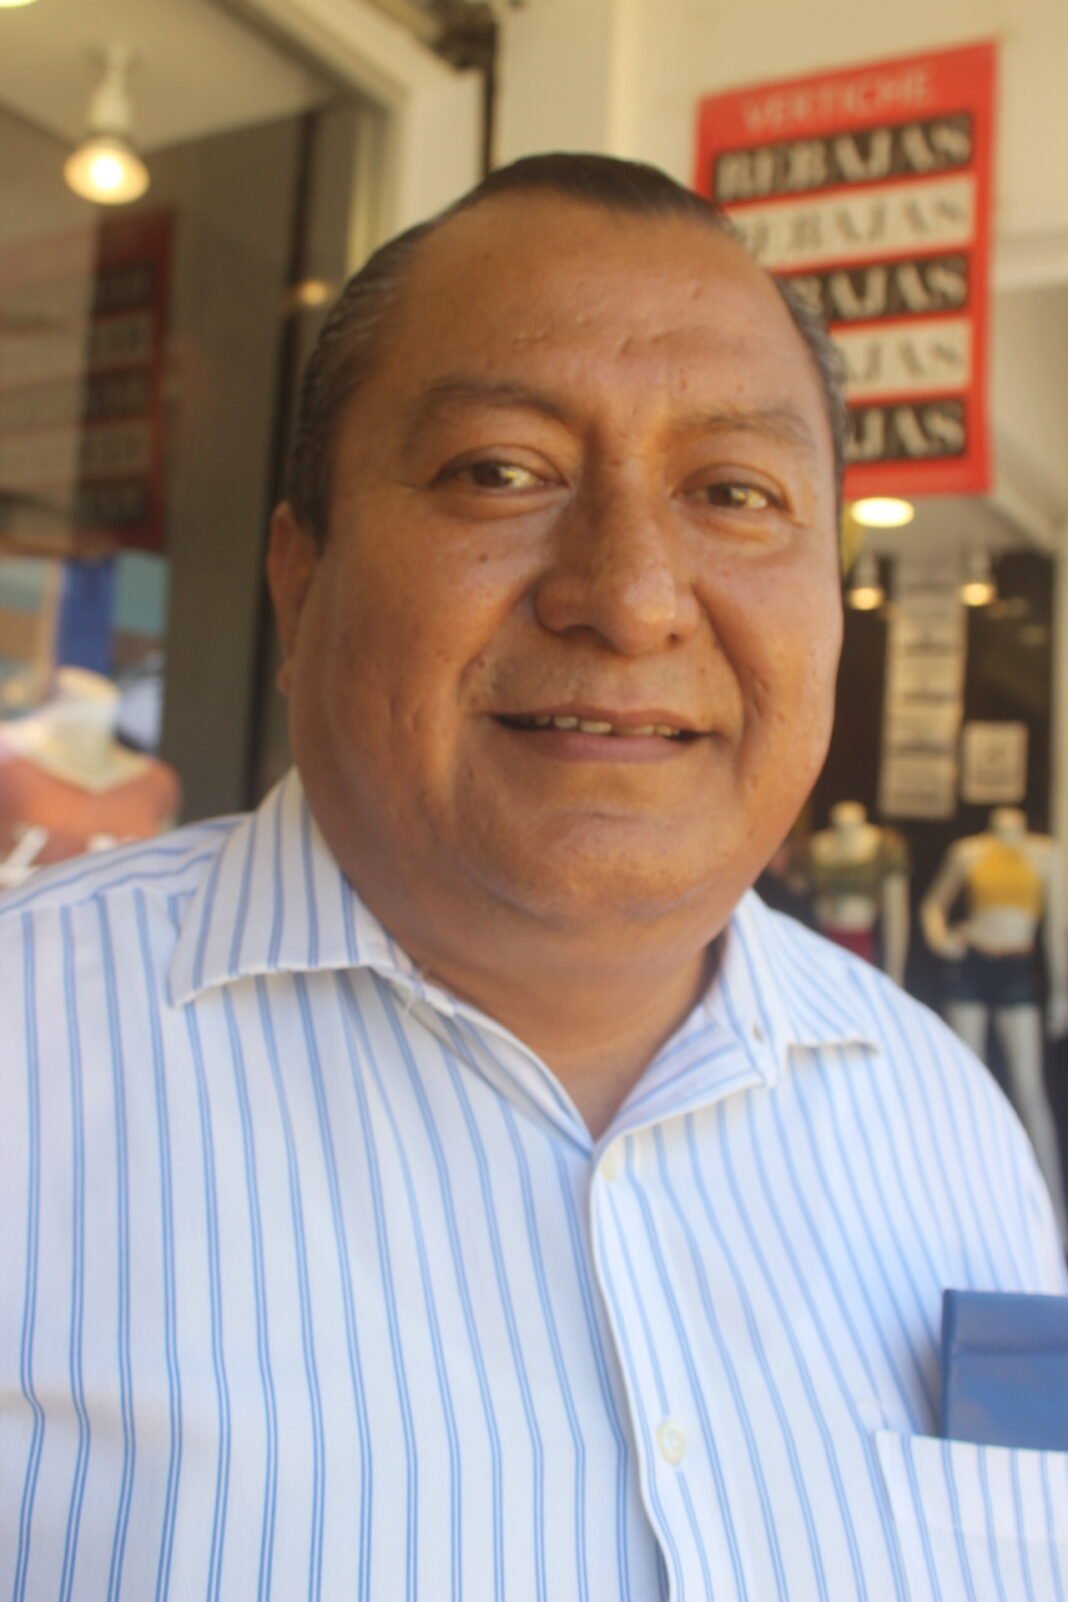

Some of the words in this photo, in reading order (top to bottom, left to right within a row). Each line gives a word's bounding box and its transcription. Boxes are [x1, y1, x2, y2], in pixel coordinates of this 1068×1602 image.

[715, 121, 969, 200] REBAJAS
[737, 194, 965, 254] EBAJAS
[783, 257, 967, 320] BAJAS
